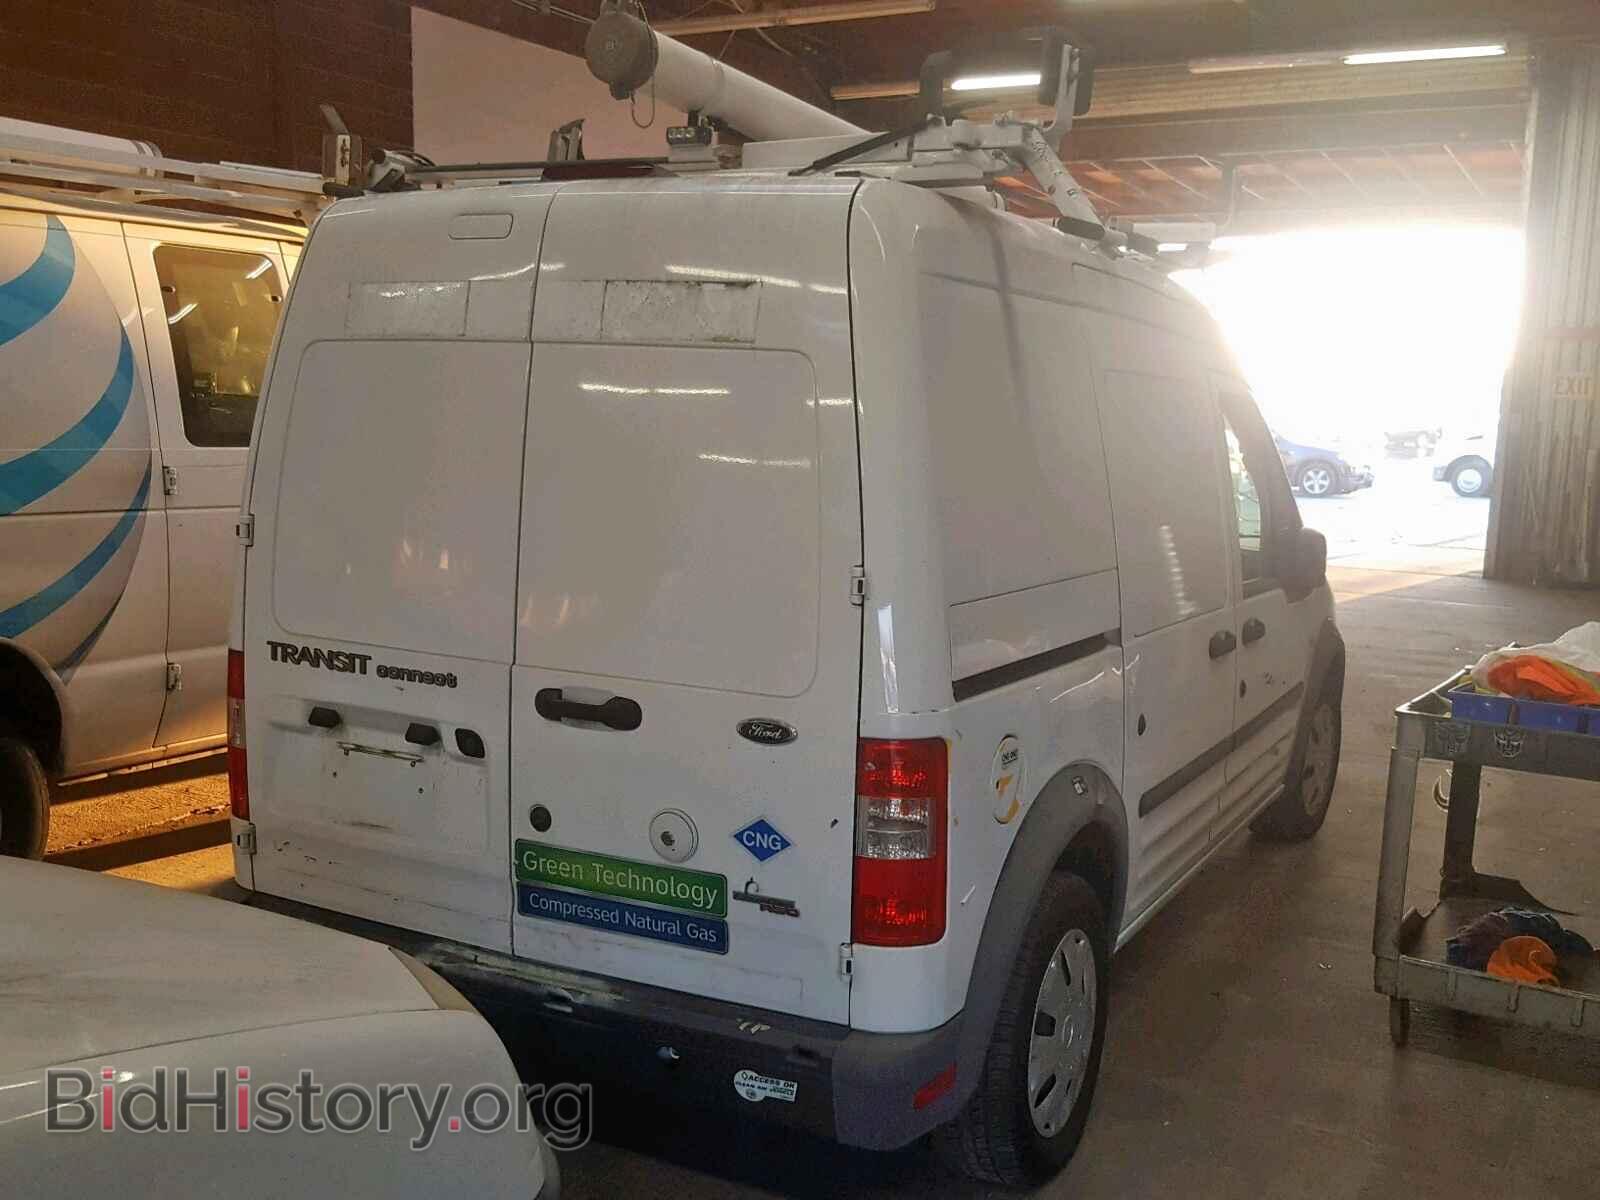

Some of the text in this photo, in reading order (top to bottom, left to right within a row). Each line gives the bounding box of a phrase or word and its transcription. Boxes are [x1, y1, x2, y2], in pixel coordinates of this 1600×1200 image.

[266, 640, 458, 689] TRANSIT connect
[743, 830, 782, 851] CNG
[523, 850, 584, 881] Green
[592, 862, 718, 910] Technology
[529, 892, 717, 943] Compressed Natural Gas
